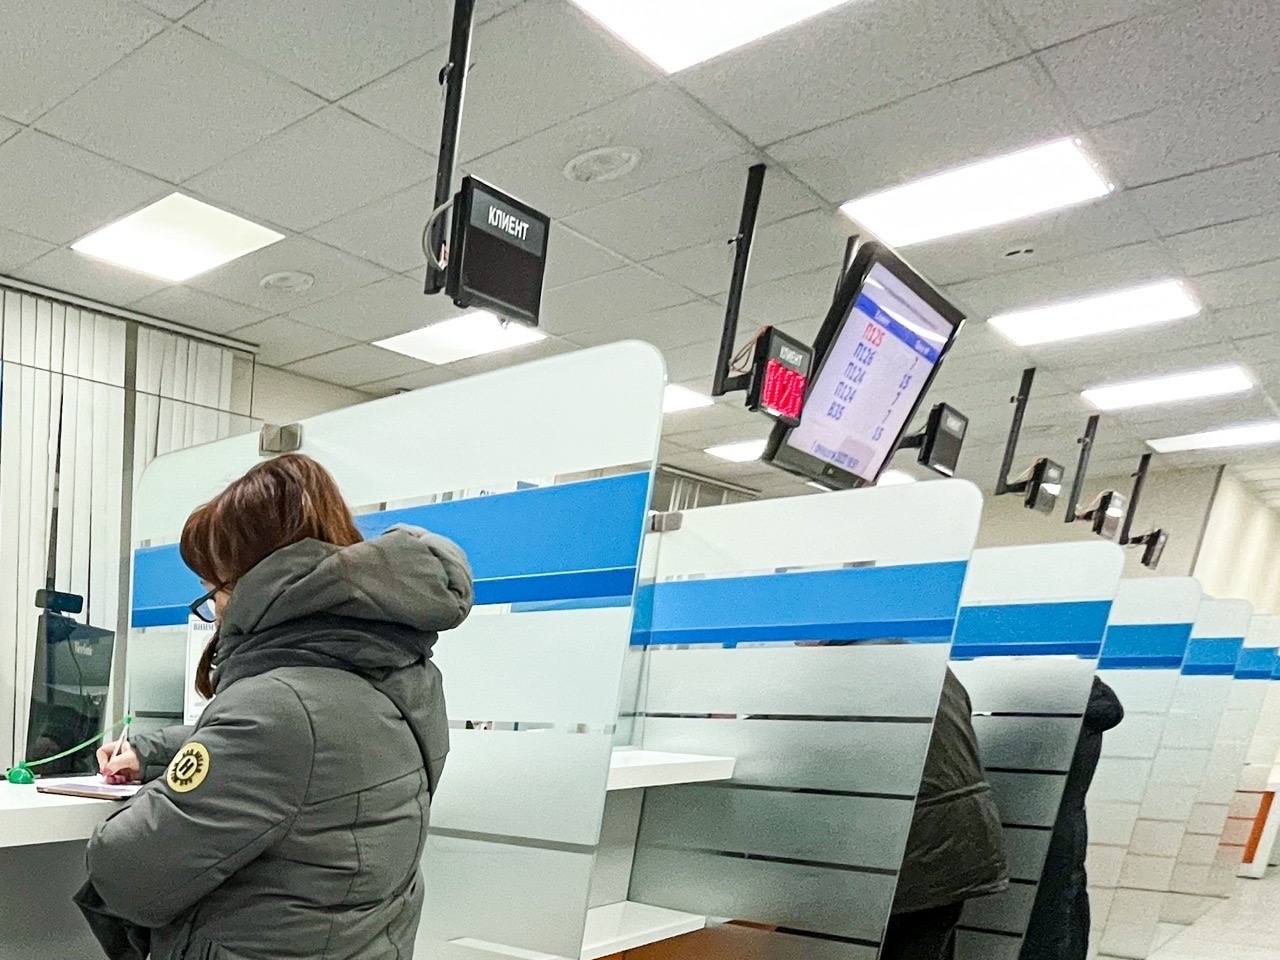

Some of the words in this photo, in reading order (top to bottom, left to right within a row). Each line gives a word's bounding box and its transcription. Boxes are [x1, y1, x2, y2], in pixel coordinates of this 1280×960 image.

[488, 205, 529, 240] КЛИЕНТ
[863, 323, 885, 347] П125
[853, 342, 877, 367] П126
